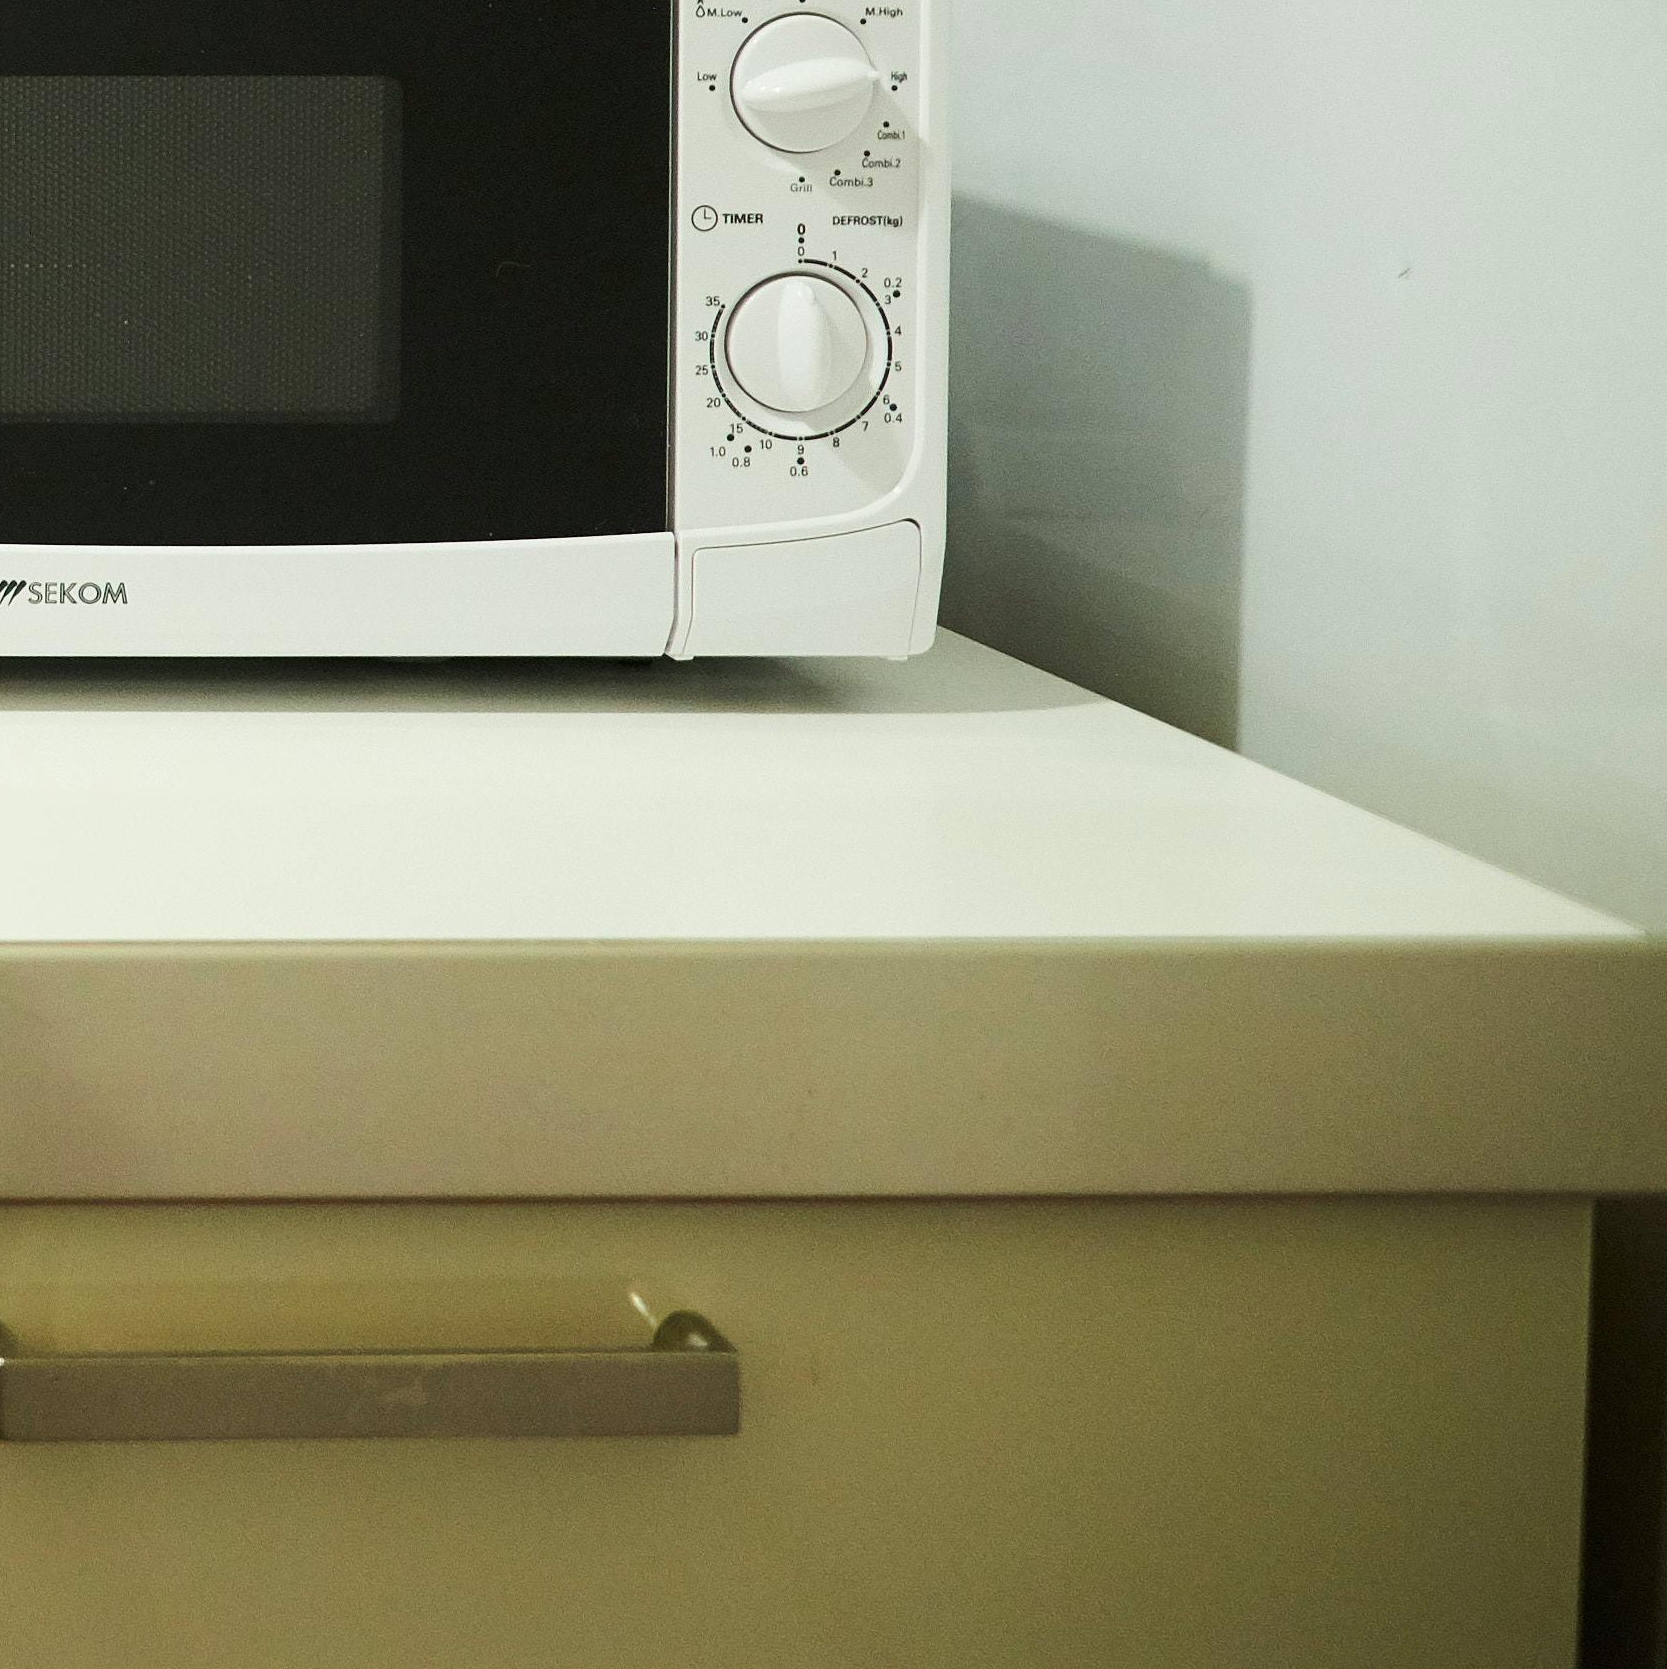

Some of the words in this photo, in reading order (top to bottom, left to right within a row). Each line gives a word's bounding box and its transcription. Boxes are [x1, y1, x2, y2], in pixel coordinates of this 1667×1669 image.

[707, 8, 742, 18] M.Low
[865, 7, 903, 18] M.High
[697, 71, 717, 82] Low
[890, 71, 908, 82] High
[861, 158, 901, 169] Combi.2
[790, 182, 813, 193] Grill
[829, 176, 874, 188] Combi.3
[722, 213, 764, 224] TIMER
[832, 215, 903, 228] DEFROST(kg)
[796, 223, 806, 236] 0
[797, 246, 805, 257] 0
[832, 251, 838, 261] 1
[861, 268, 869, 278] 2
[883, 278, 902, 289] 0.2
[705, 297, 721, 307] 35
[884, 295, 892, 305] 3
[694, 332, 709, 341] 30
[894, 327, 902, 336] 4
[695, 365, 709, 375] 25
[895, 361, 903, 371] 5
[706, 398, 722, 408] 20
[883, 394, 891, 405] 6
[884, 412, 903, 423] 0.4
[730, 423, 744, 434] 15
[862, 421, 869, 431] 7
[760, 439, 772, 449] 10
[833, 438, 840, 448] 8
[710, 446, 726, 457] 1.0
[797, 445, 805, 455] 9
[732, 457, 751, 468] 0.8
[790, 466, 809, 477] 0.6
[28, 582, 128, 604] SEKOM
